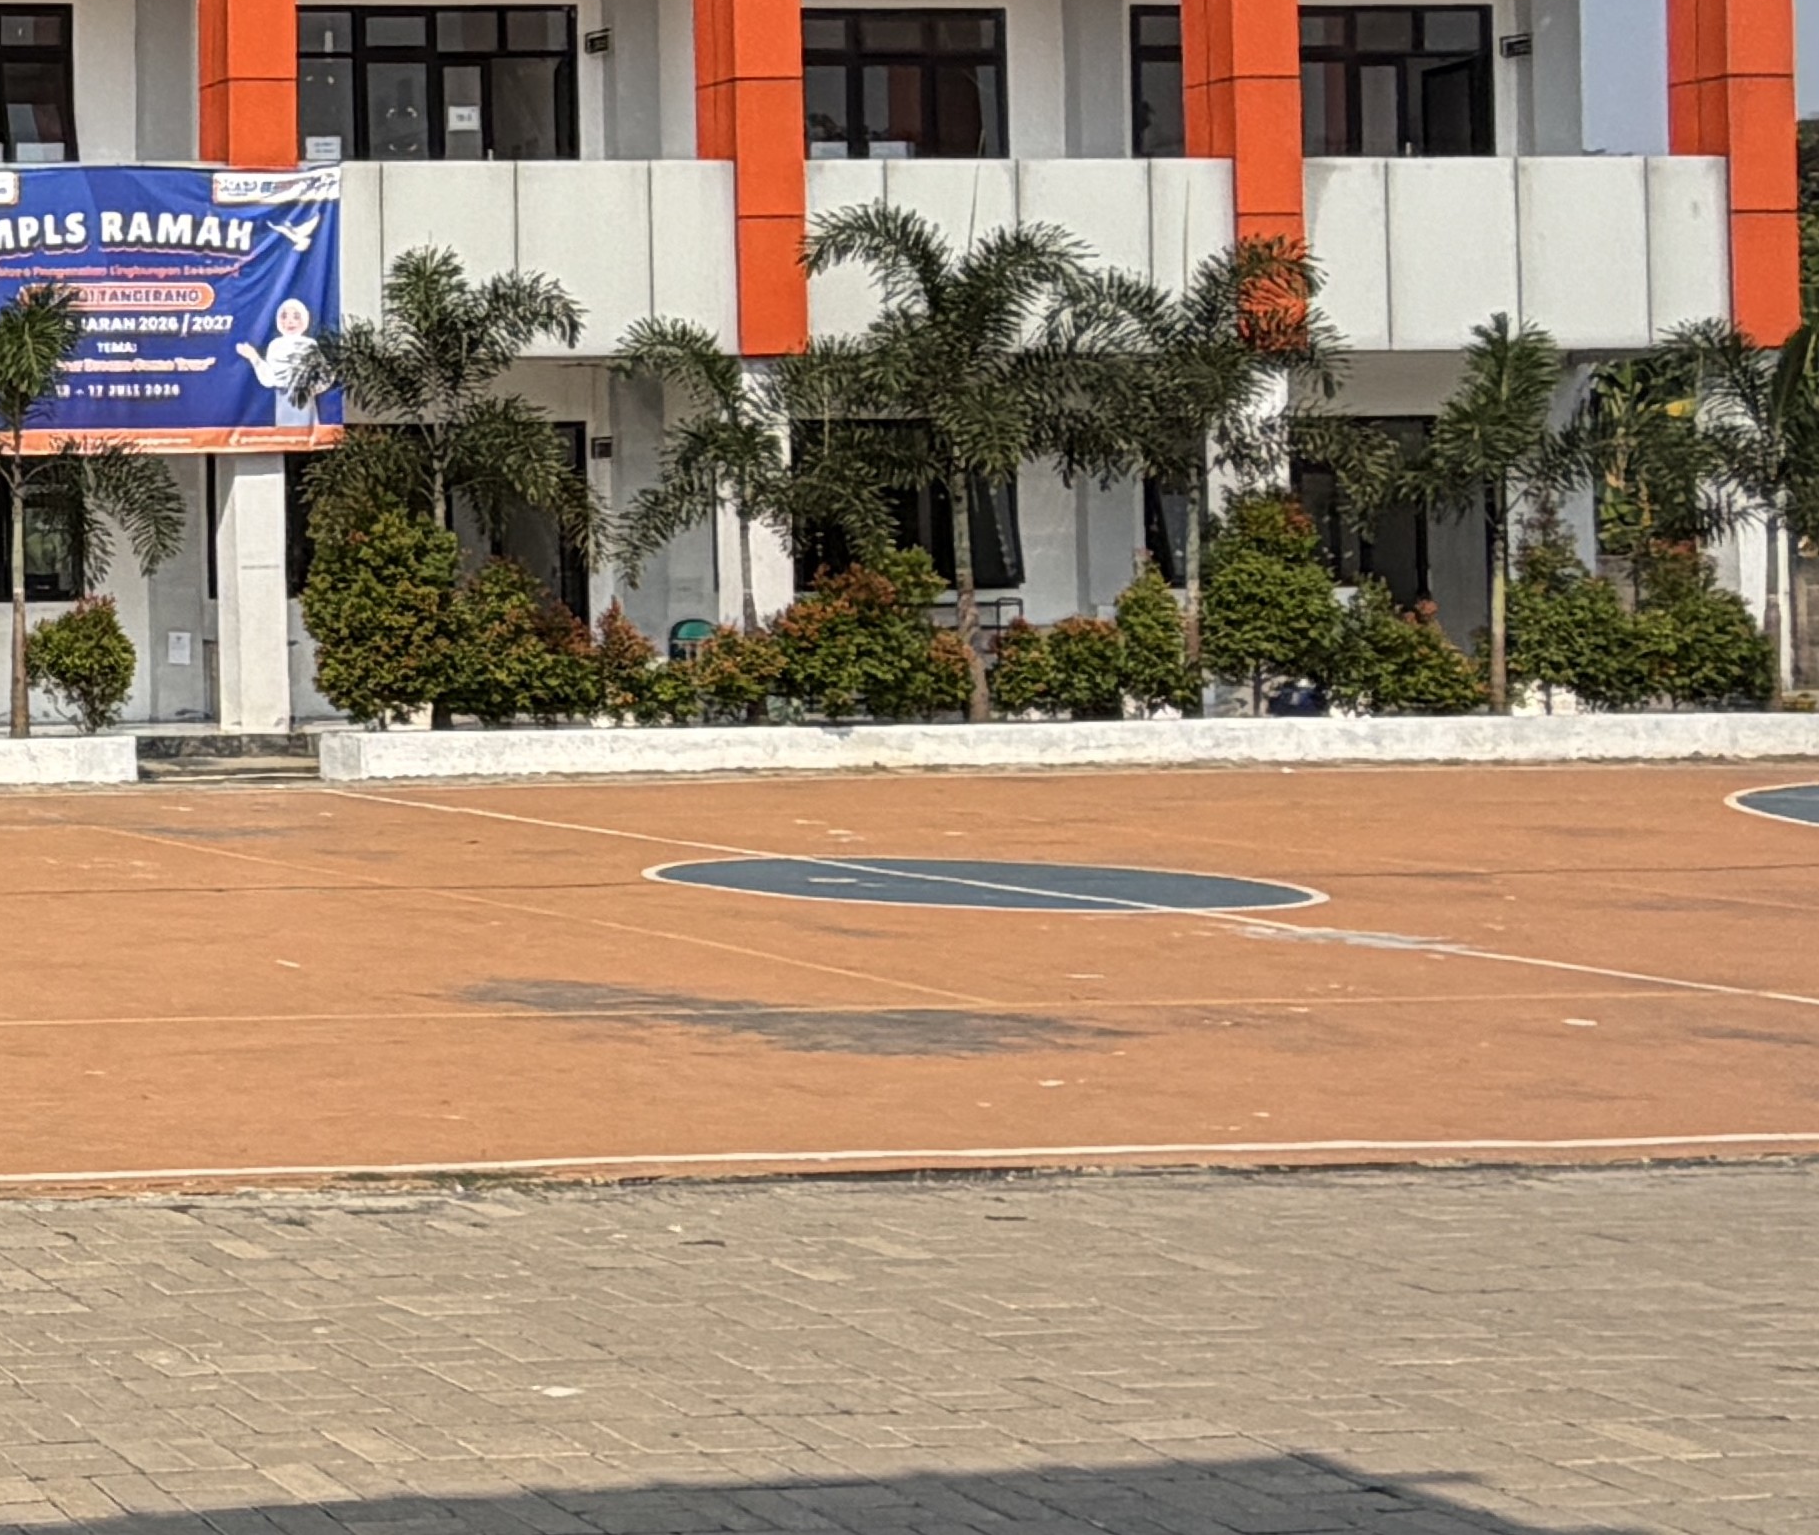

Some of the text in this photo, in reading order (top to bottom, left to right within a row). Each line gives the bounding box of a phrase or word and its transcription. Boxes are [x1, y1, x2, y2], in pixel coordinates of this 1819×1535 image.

[100, 210, 255, 252] RAMAH
[138, 316, 179, 331] 2026
[191, 315, 234, 331] 2027
[108, 383, 141, 397] JULI
